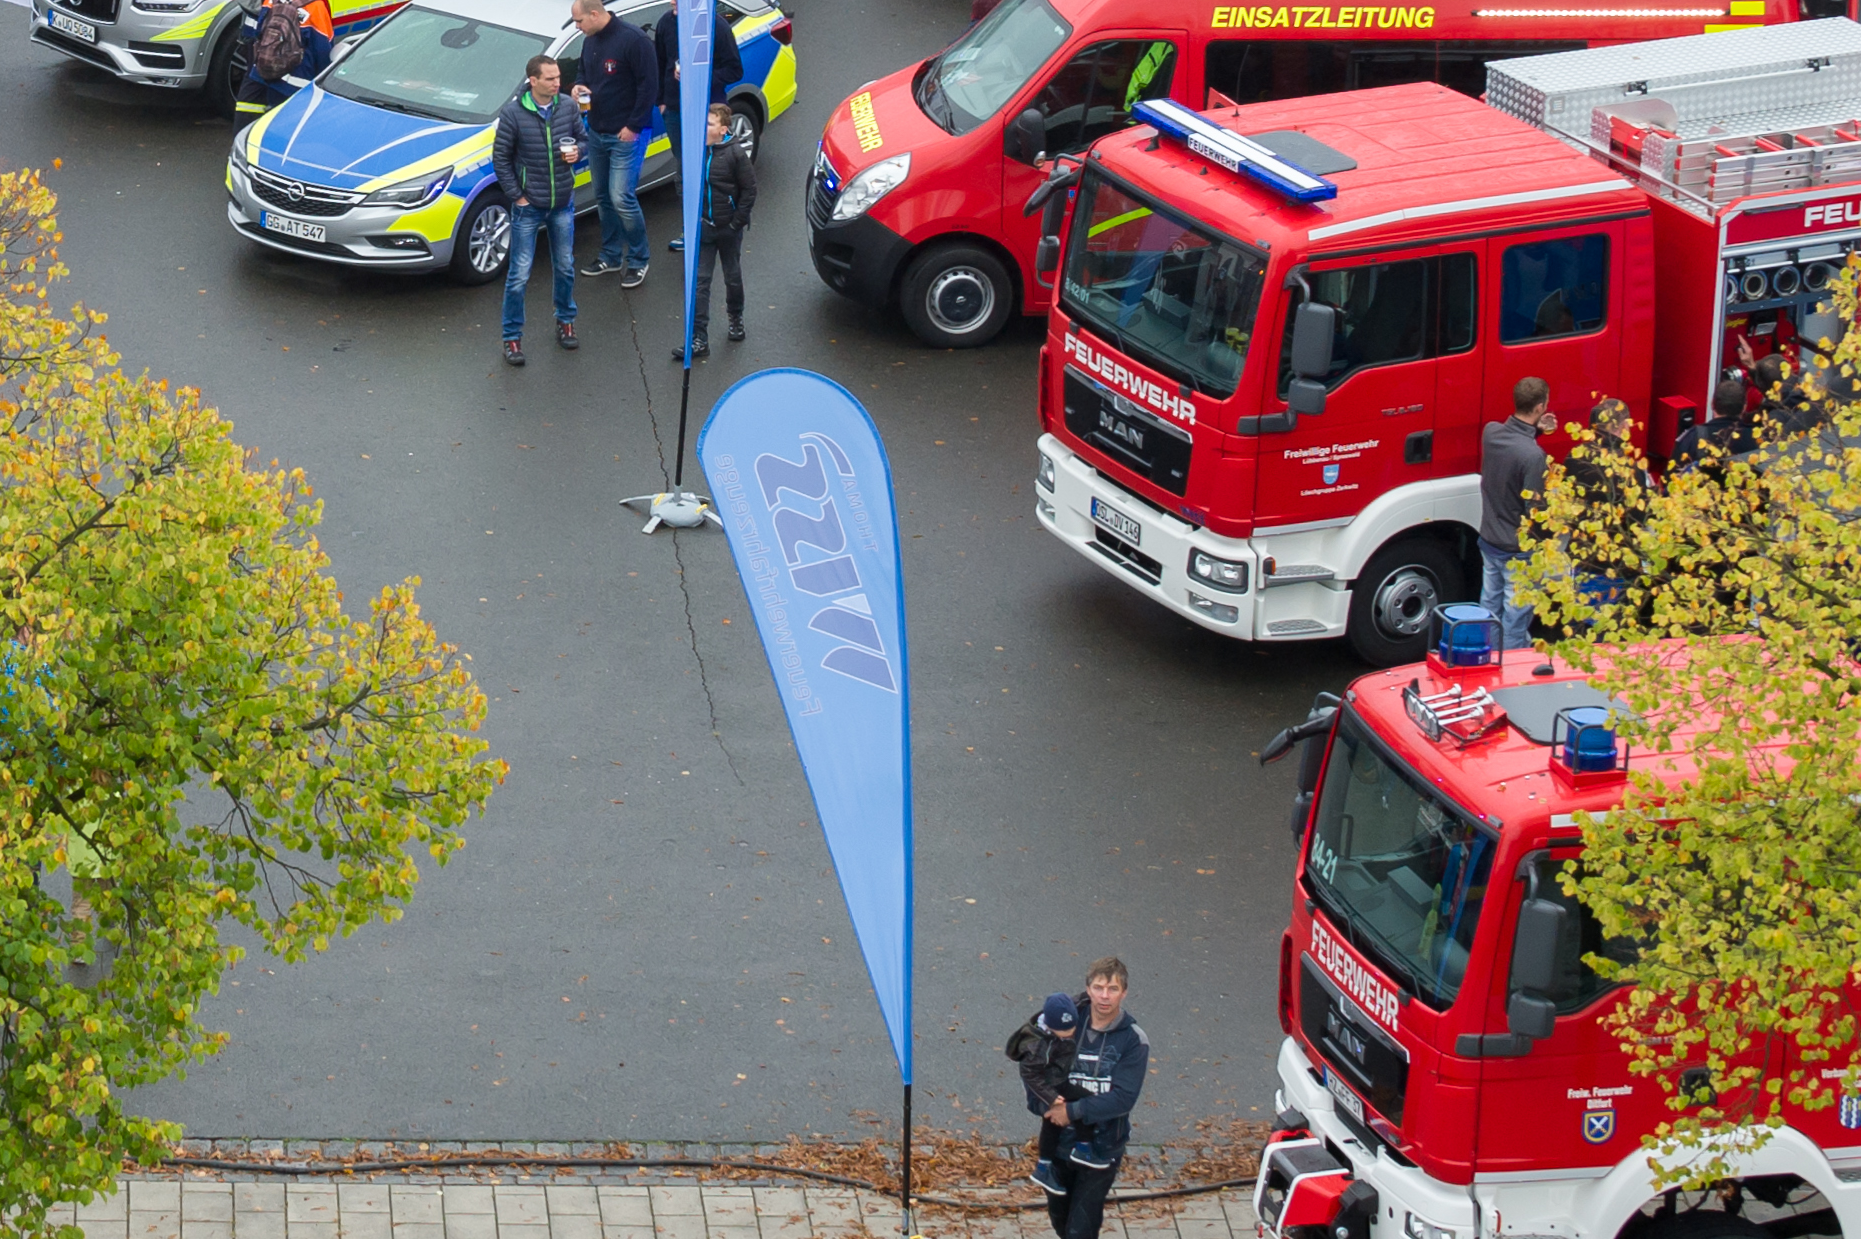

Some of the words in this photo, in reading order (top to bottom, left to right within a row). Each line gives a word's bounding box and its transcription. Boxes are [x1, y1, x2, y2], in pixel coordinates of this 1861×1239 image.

[1211, 5, 1435, 29] EINSATZLEITUNG
[850, 91, 884, 154] FEUERWEHR
[1189, 136, 1237, 171] FEUERWEHR
[266, 214, 279, 228] GG
[286, 220, 300, 234] AT
[302, 224, 324, 240] 547
[1064, 331, 1197, 425] FEUERWEHR
[1099, 410, 1144, 450] MAN
[1283, 444, 1331, 460] Freiwillige
[1332, 438, 1380, 454] Feuerwehr
[1114, 509, 1124, 531] DV
[1124, 518, 1139, 539] 146
[1312, 832, 1337, 885] 84-21
[1311, 919, 1399, 1031] FEUERWEHR
[1327, 1011, 1366, 1065] MAN
[1592, 1085, 1633, 1097] Feuerwehr
